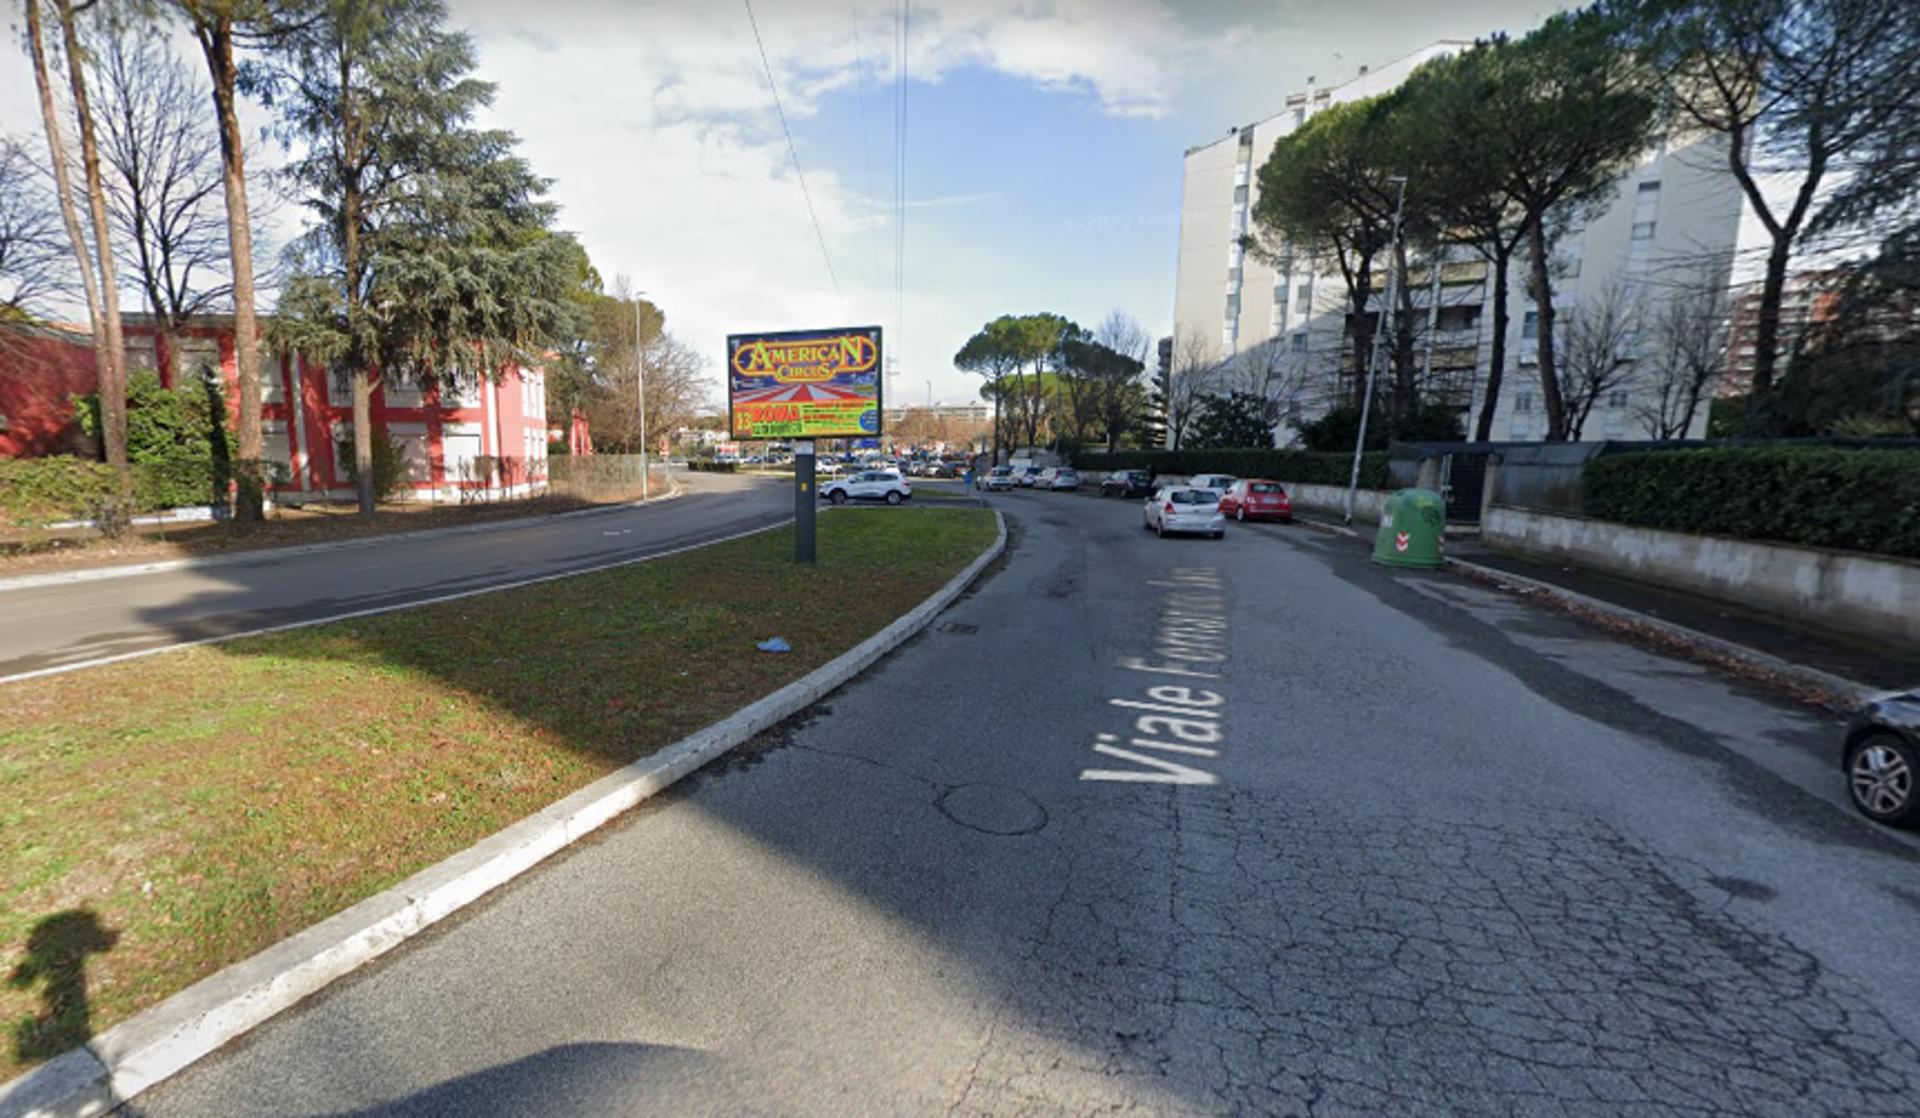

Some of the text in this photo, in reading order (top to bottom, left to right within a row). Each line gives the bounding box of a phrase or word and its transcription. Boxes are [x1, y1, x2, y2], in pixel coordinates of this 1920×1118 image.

[747, 336, 867, 372] AMERICAN
[776, 364, 830, 378] CIRCUS
[753, 406, 800, 423] ROMA
